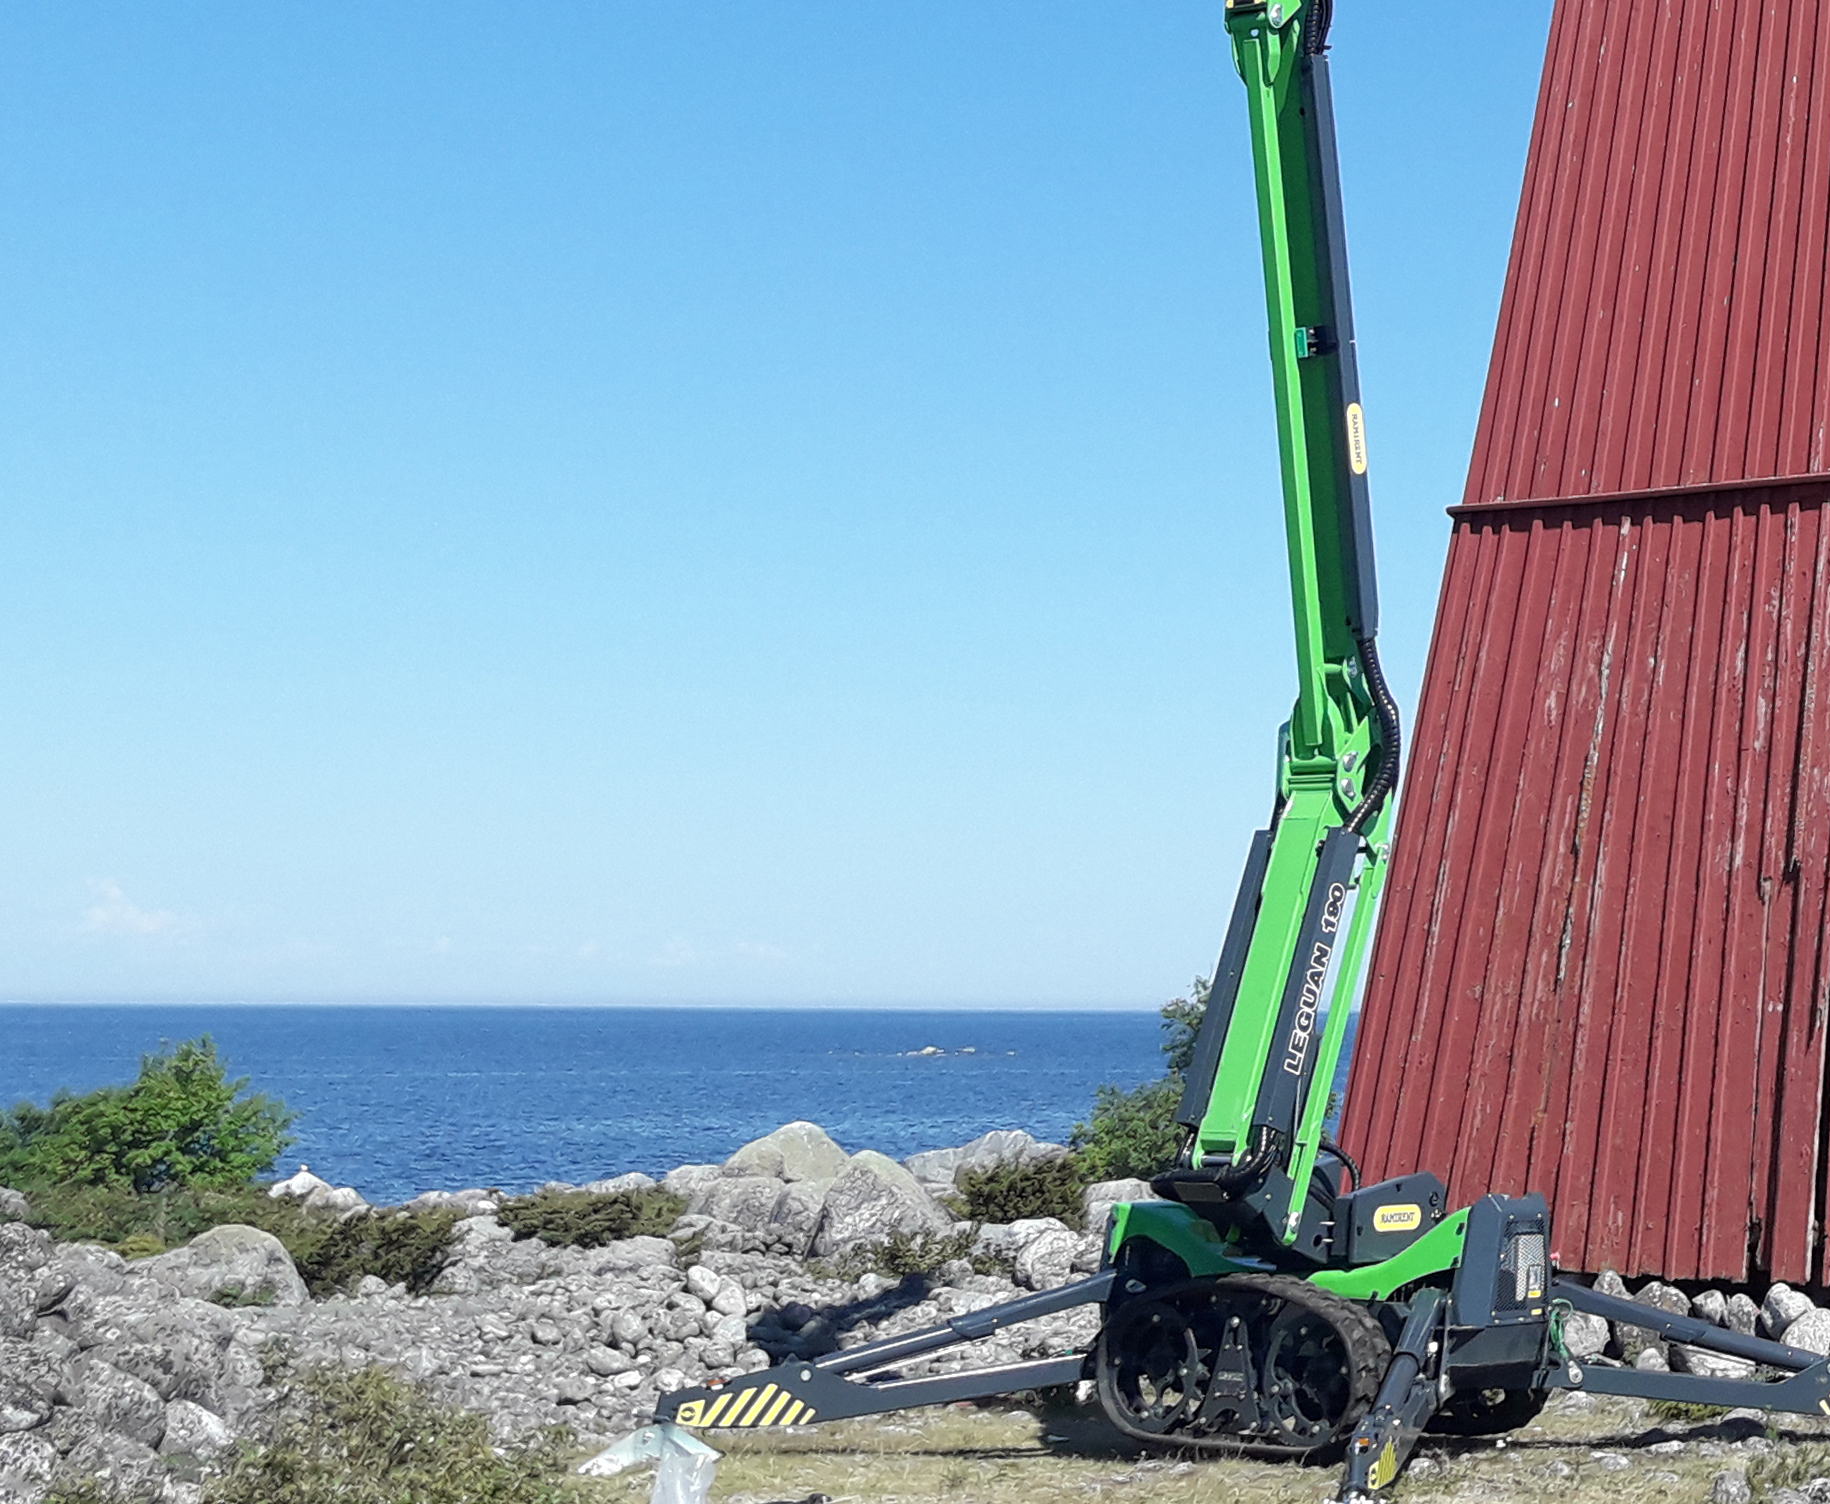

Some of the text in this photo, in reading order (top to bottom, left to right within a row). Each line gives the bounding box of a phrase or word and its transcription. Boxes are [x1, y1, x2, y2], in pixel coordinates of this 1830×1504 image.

[1352, 414, 1362, 464] RAMIRENT
[1284, 883, 1345, 1075] LEGUAN 190
